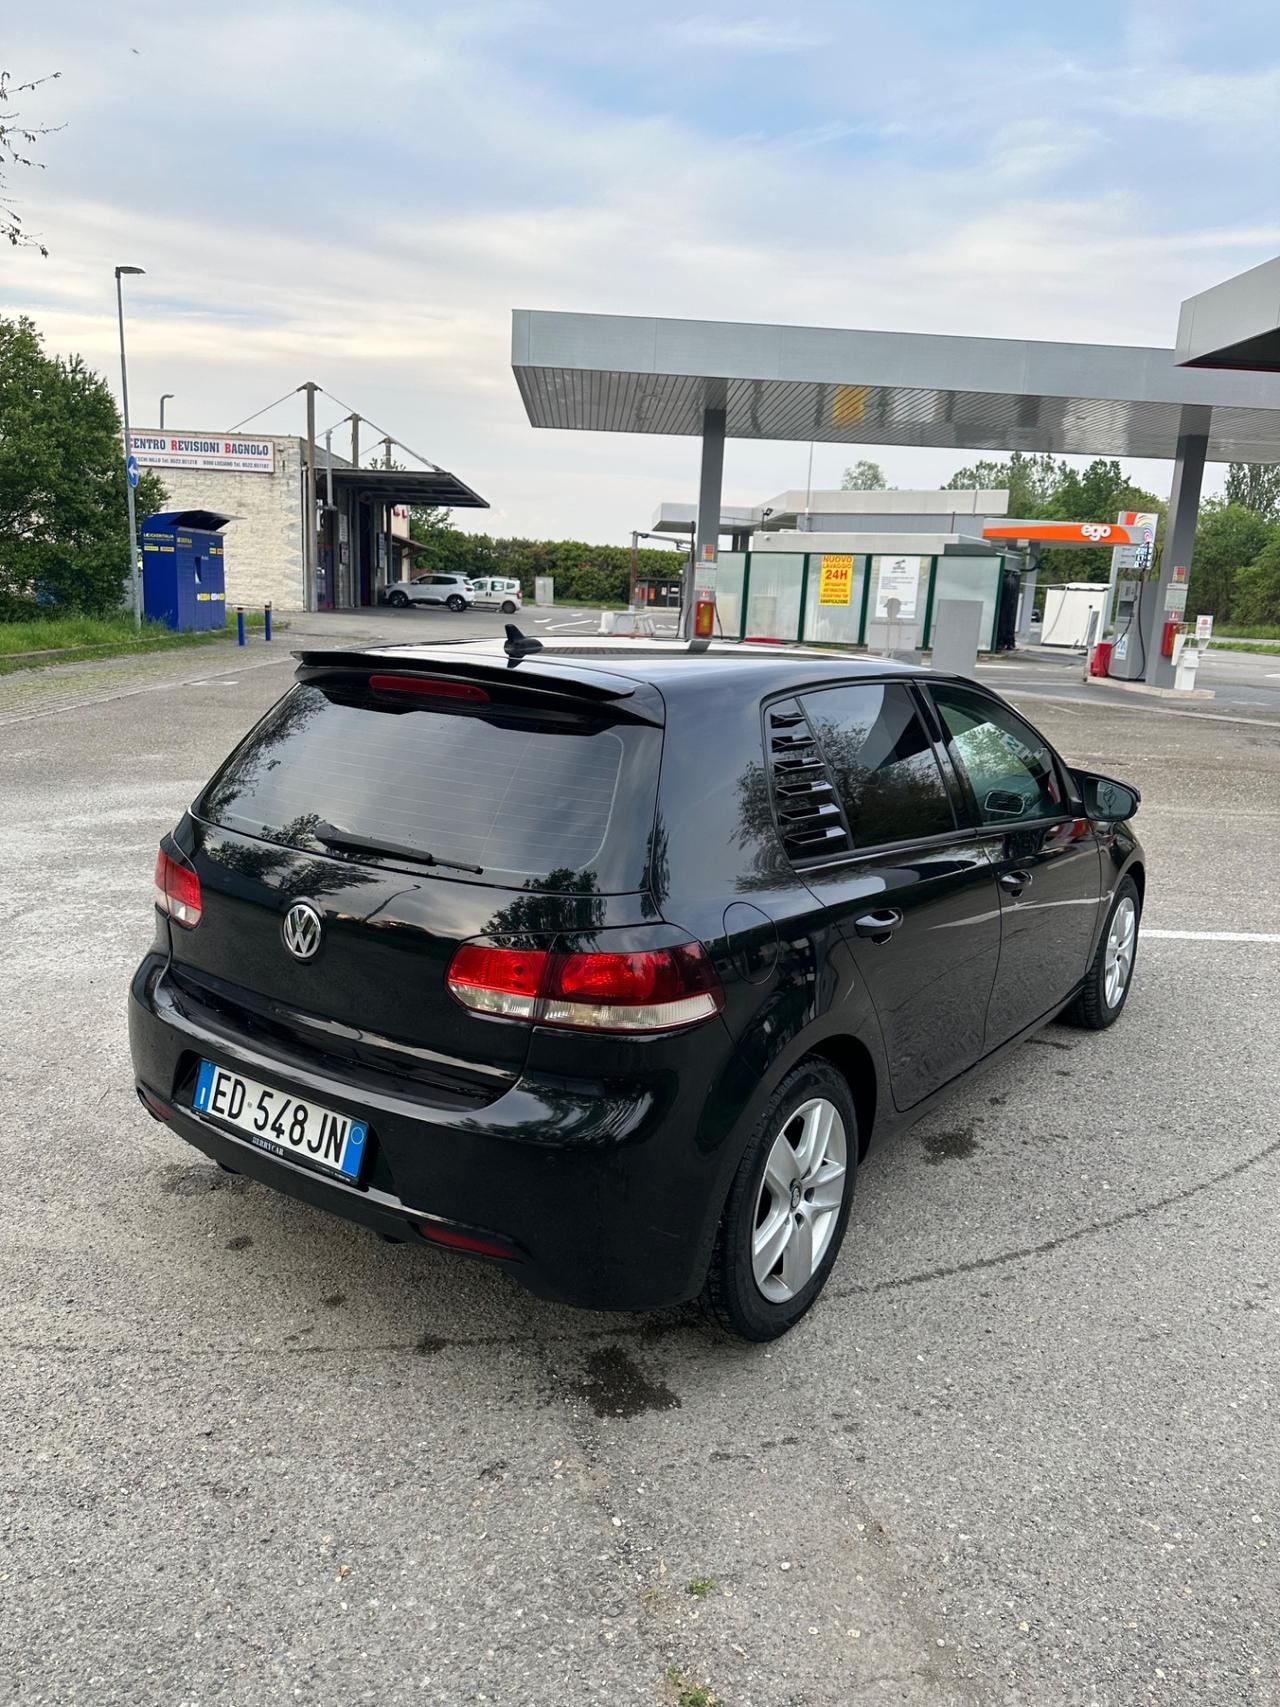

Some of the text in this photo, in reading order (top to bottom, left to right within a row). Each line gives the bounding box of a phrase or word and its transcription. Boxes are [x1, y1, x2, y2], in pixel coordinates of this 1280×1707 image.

[171, 439, 219, 453] REVISIONI
[225, 442, 269, 456] BAGNOLO
[1080, 524, 1111, 542] ego
[823, 555, 852, 563] NUOVO
[825, 569, 848, 580] 24H
[284, 905, 320, 957] VW
[211, 1071, 348, 1163] ED 548JN
